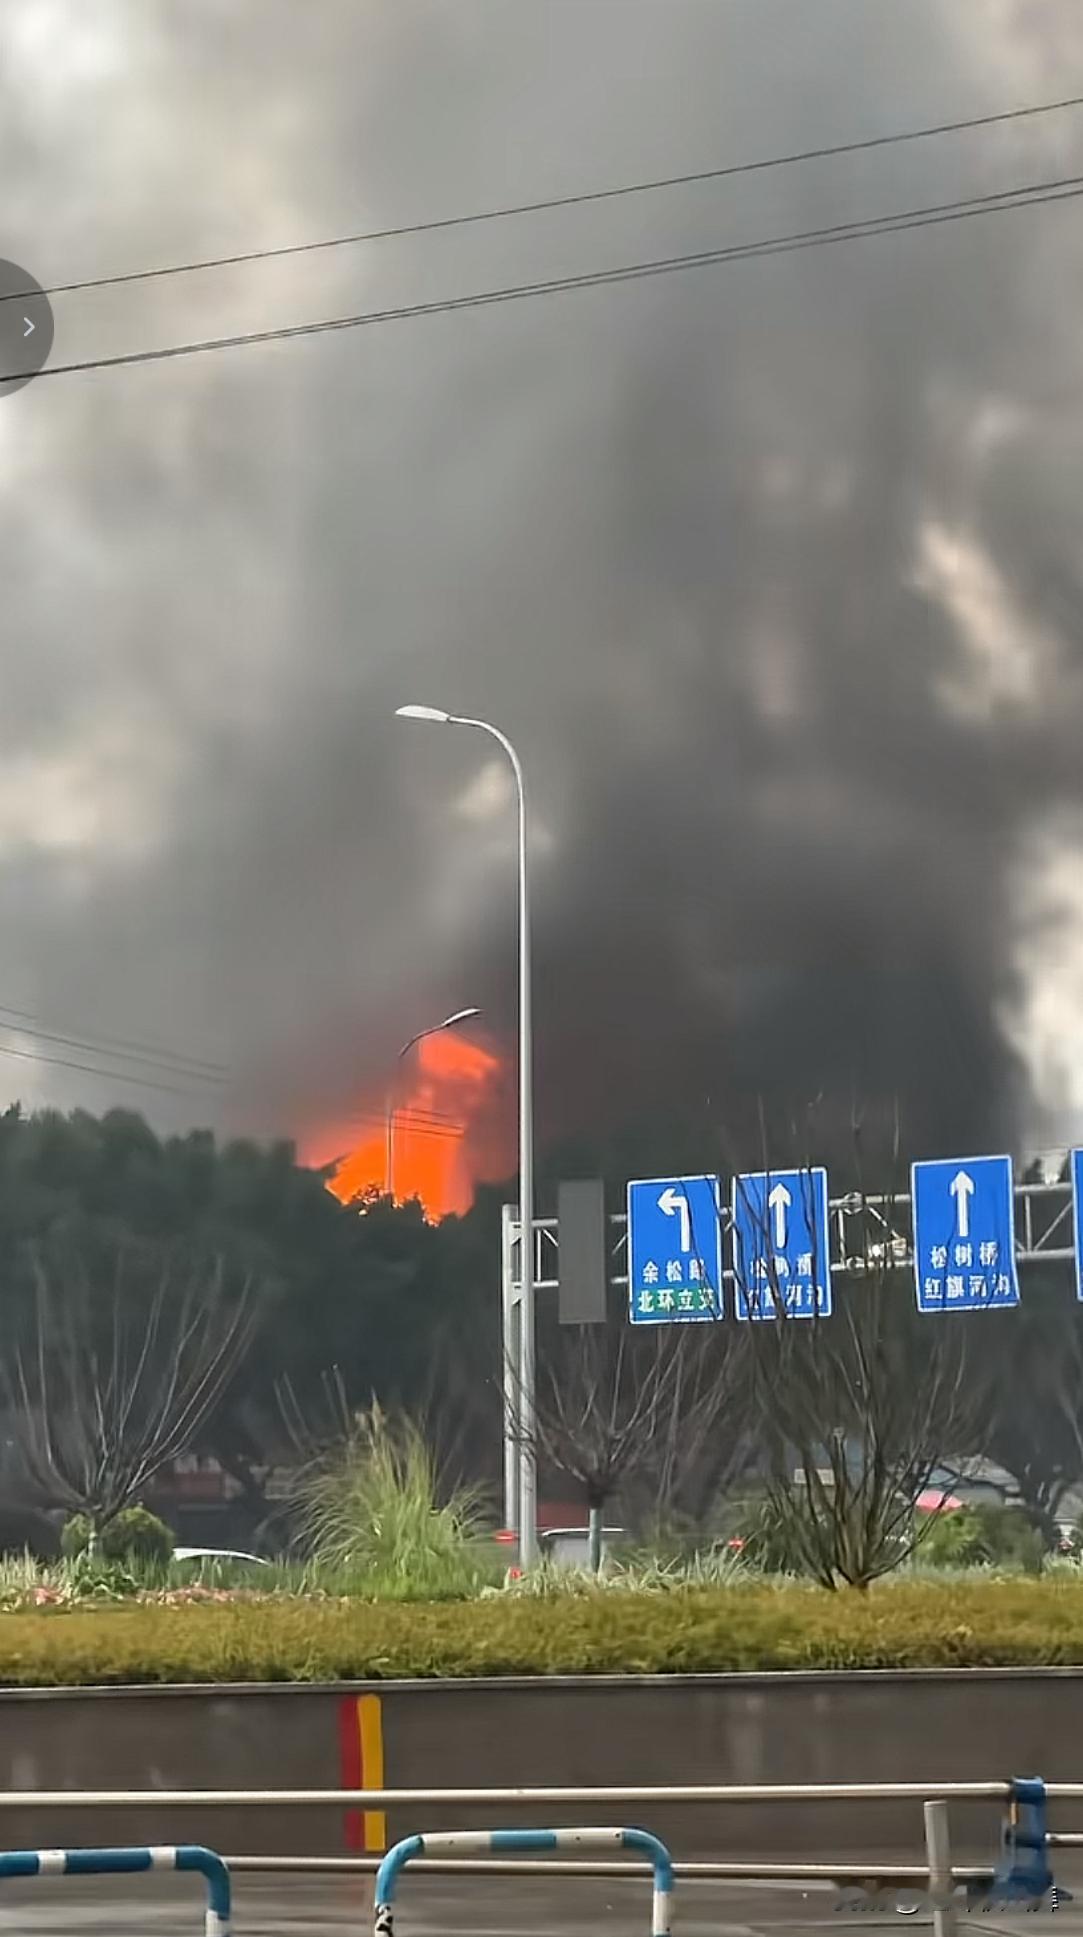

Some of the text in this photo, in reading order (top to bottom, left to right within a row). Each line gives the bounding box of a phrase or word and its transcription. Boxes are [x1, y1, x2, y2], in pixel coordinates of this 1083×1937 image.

[930, 1241, 998, 1269] 松树桥
[924, 1272, 1010, 1299] 红旗河沟
